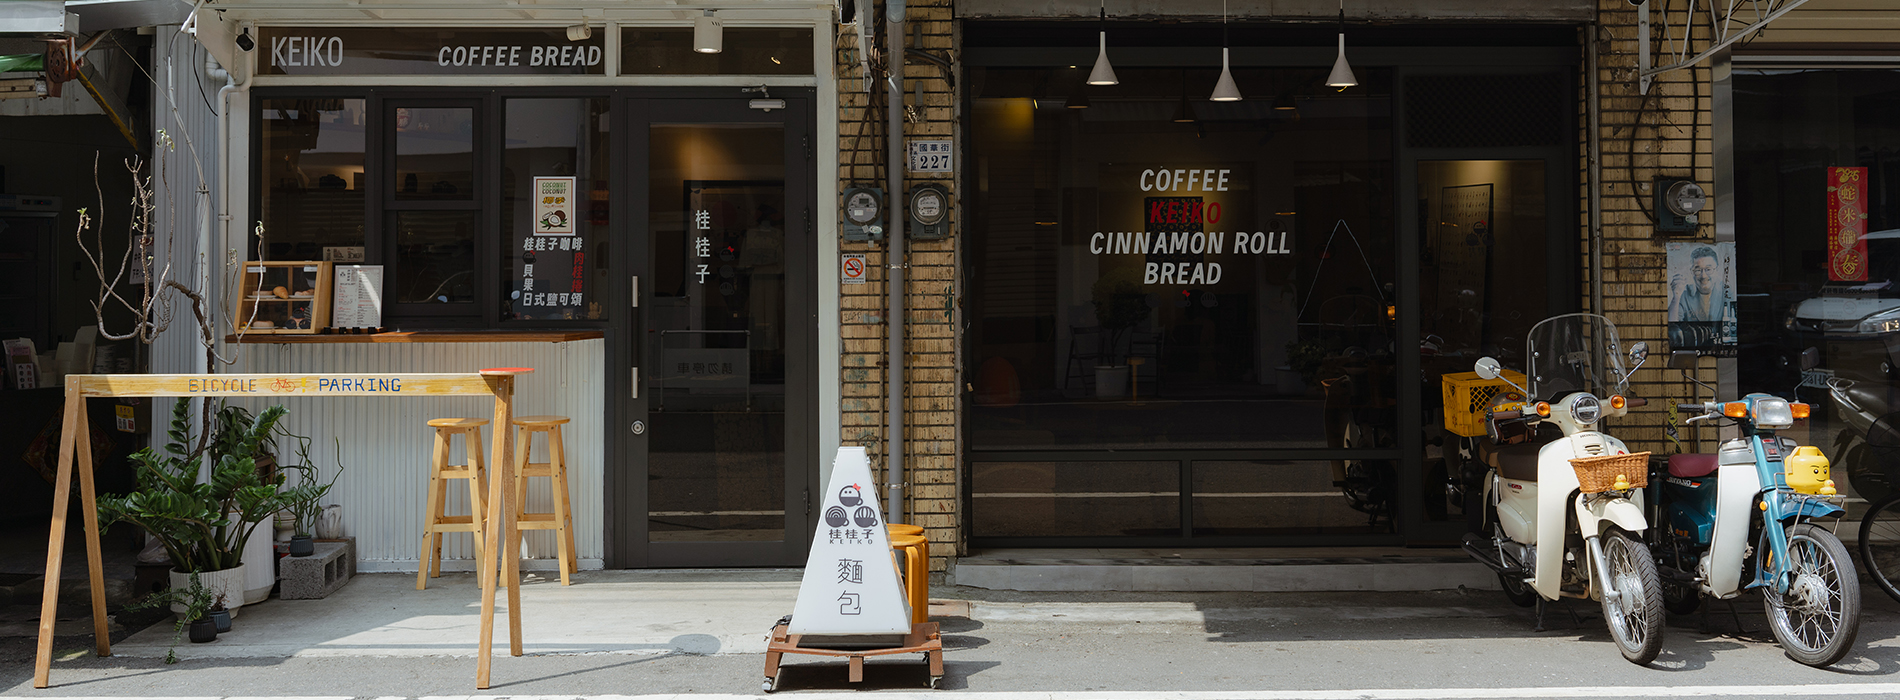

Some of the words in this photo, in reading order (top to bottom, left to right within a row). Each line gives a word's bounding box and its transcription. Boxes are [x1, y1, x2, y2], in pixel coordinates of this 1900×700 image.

[271, 36, 344, 67] KEIKO
[437, 45, 522, 67] COFFEE
[529, 45, 602, 67] BREAD
[919, 143, 950, 152] 國華街
[920, 155, 949, 169] 227
[1139, 168, 1231, 192] COFFEE
[1150, 201, 1222, 224] KEIKO
[523, 237, 583, 251] 桂桂子咖啡
[695, 209, 711, 284] 桂桂子
[1089, 231, 1225, 255] CINNAMON
[1233, 231, 1291, 255] ROLL
[523, 264, 534, 291] 貝果
[570, 252, 585, 293] 肉桂捲
[1143, 262, 1223, 285] BREAD
[523, 292, 583, 307] 日式鹽可頌
[188, 378, 257, 393] BICYCLE
[318, 378, 402, 392] PARKING
[828, 528, 875, 540] 桂桂子
[837, 558, 863, 616] 麵包
